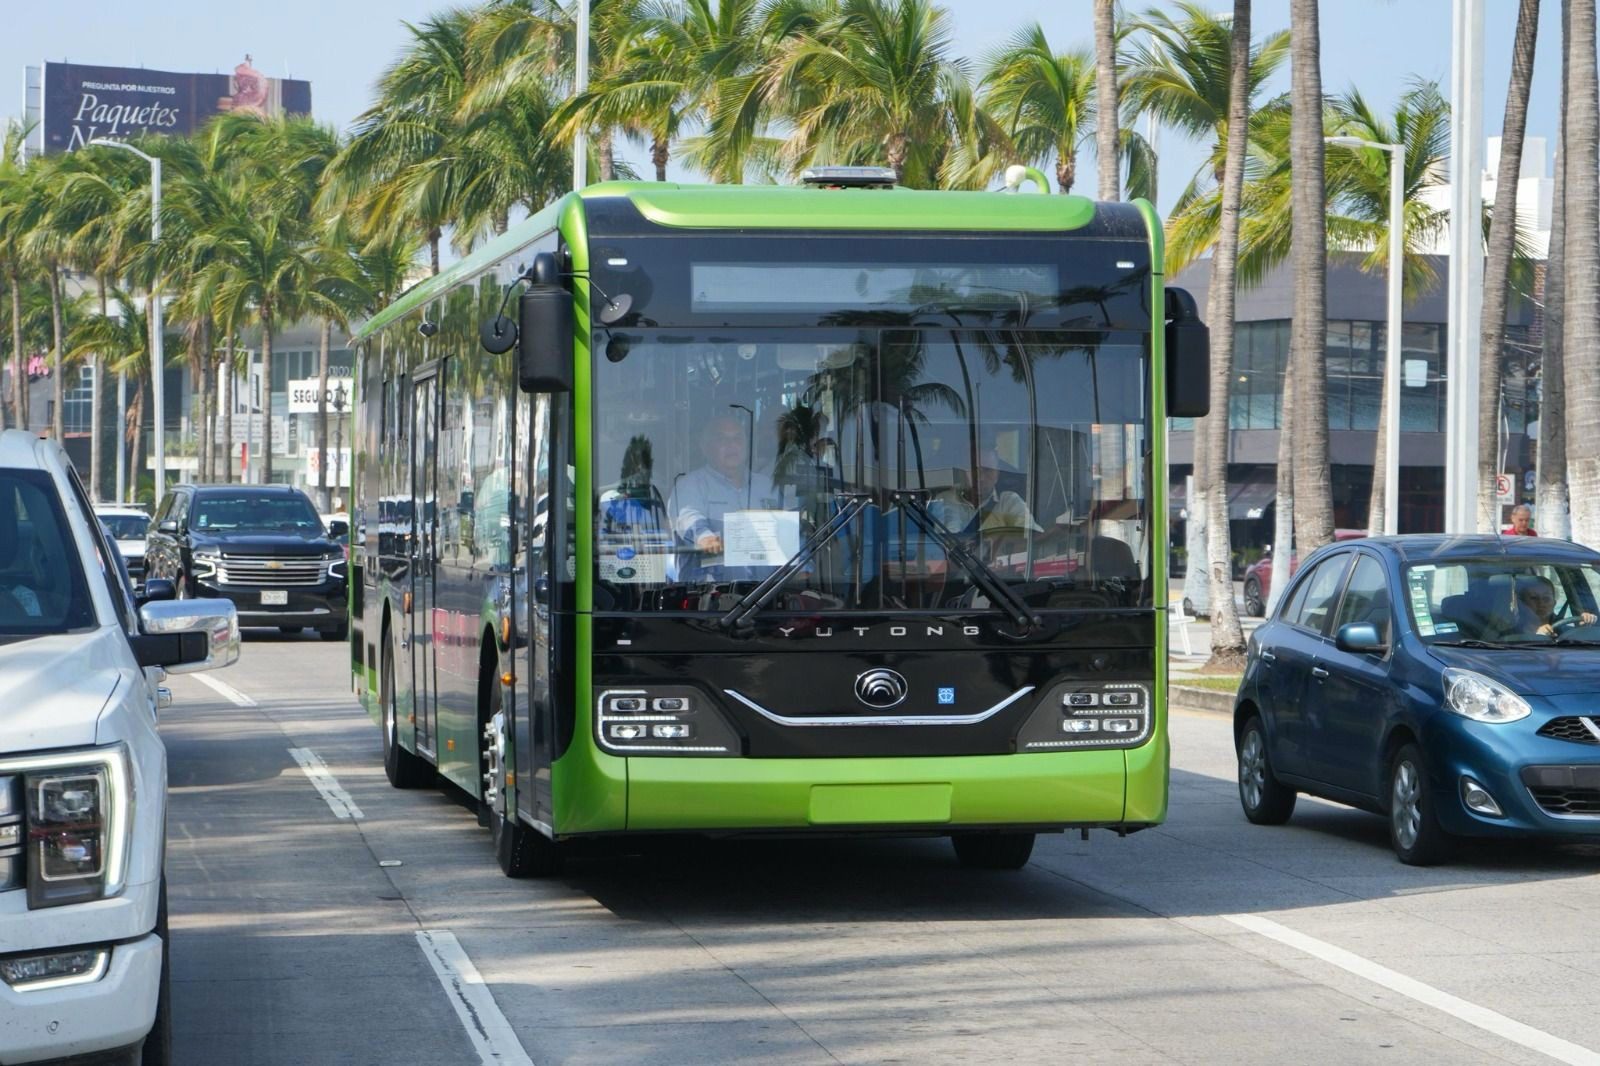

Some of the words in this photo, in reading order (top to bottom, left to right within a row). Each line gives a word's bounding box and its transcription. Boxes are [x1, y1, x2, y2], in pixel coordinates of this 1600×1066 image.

[82, 81, 120, 91] PREGUNTA
[121, 84, 137, 92] POR
[137, 85, 176, 95] NUESTROS
[73, 93, 180, 135] Paquetes
[294, 389, 341, 404] SEGUO
[779, 626, 980, 637] YUTONG
